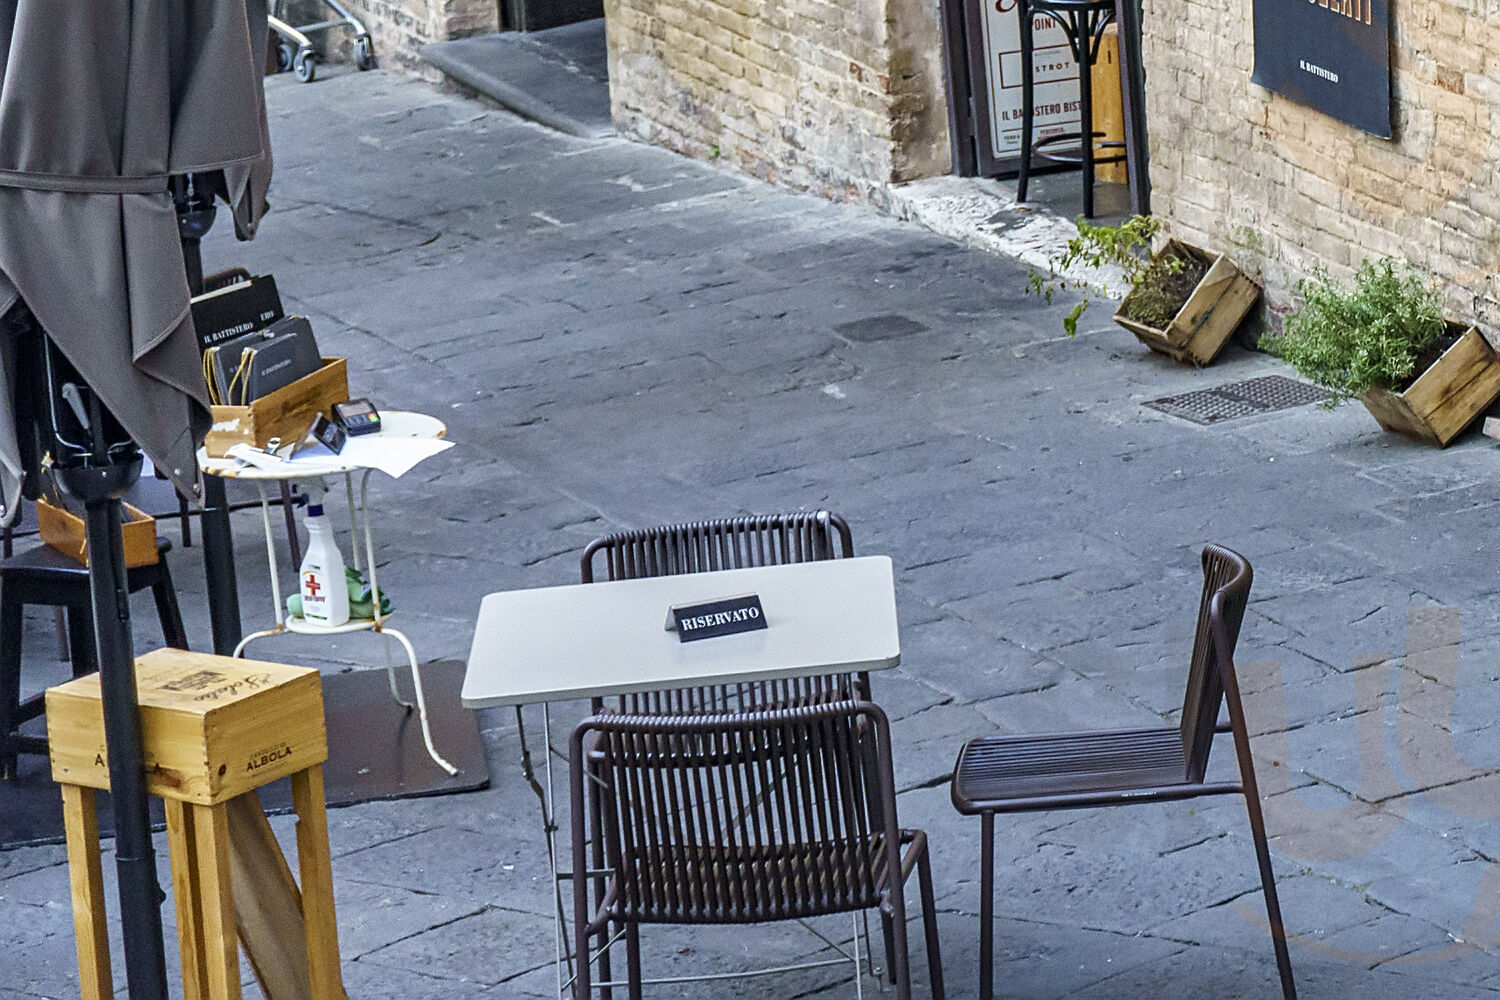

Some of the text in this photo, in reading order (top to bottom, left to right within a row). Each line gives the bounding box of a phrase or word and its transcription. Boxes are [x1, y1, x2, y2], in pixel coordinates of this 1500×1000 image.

[1306, 62, 1338, 83] BATTISTERO
[212, 322, 254, 341] BATTISTERO
[681, 606, 759, 631] RISERVATO
[246, 746, 292, 772] ALBOLA
